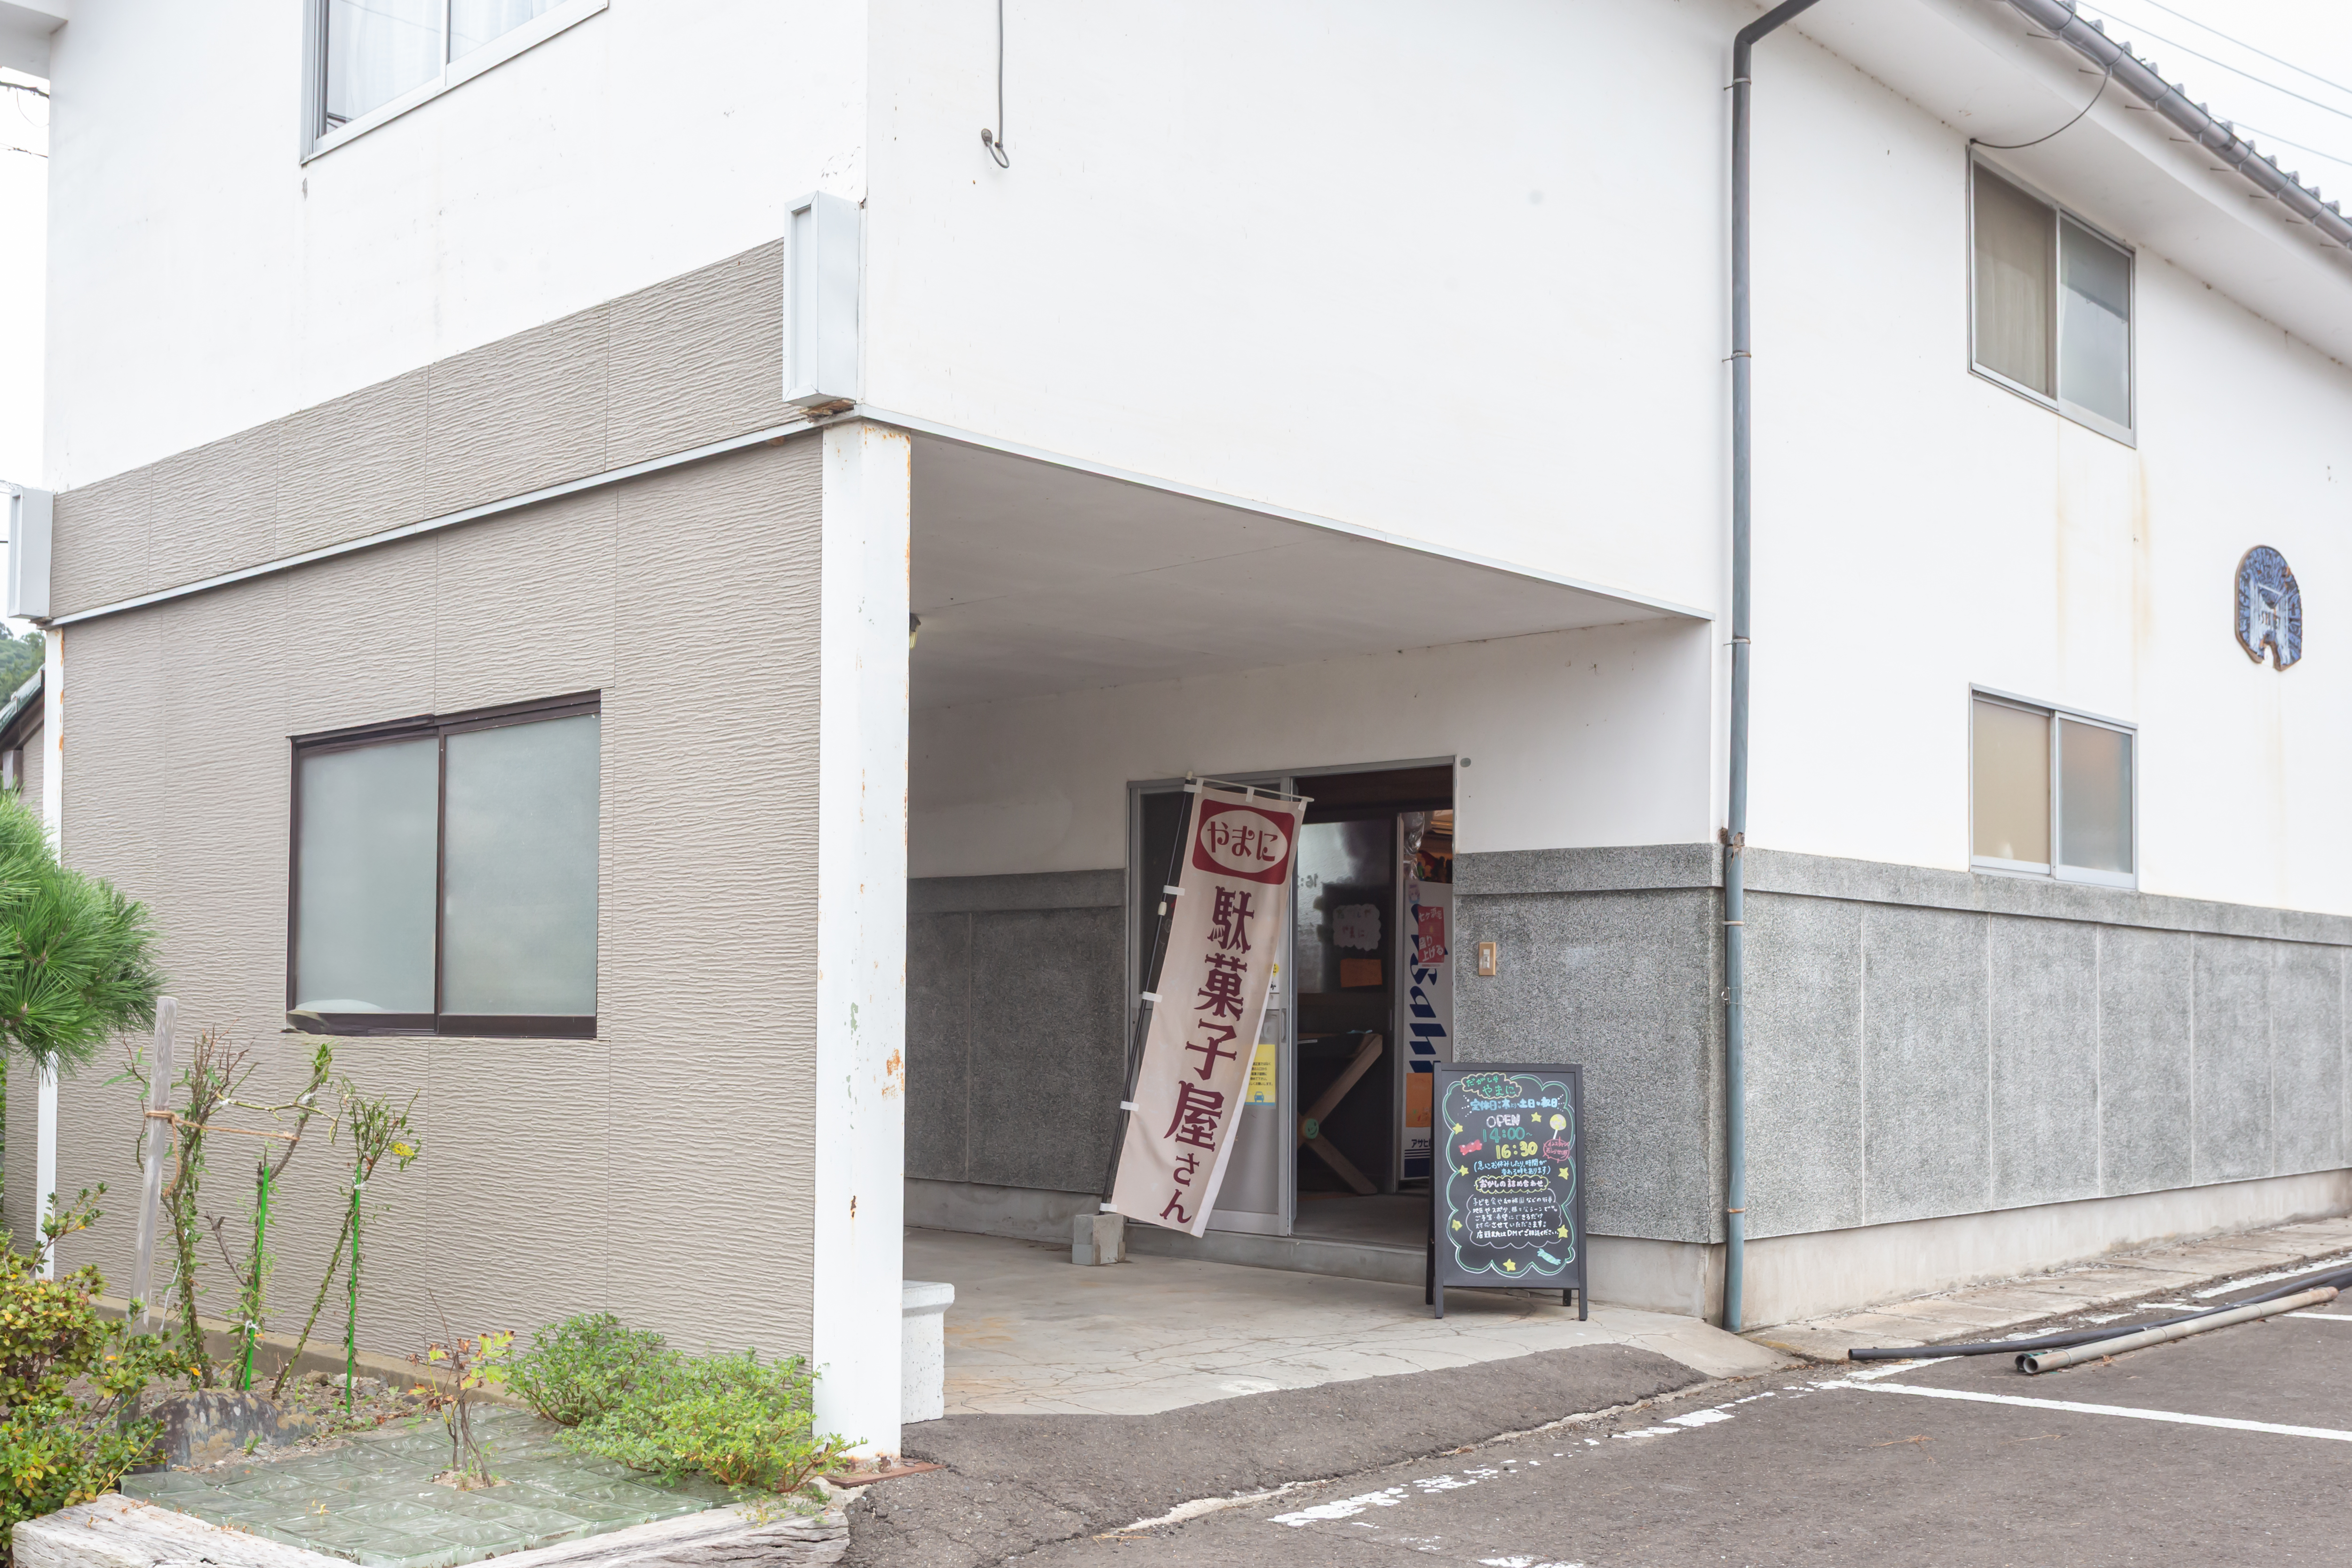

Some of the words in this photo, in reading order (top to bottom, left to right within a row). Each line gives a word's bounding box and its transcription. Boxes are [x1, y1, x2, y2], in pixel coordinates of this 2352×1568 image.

[1207, 821, 1278, 862] やまに
[1422, 944, 1444, 962] 上げる
[1159, 885, 1255, 1224] 駄菓子屋さん
[1466, 1075, 1499, 1087] だがしや
[1482, 1084, 1516, 1098] やまに
[1486, 1114, 1520, 1128] OPEN
[1412, 1138, 1430, 1148] アサヒ
[1496, 1141, 1538, 1159] 16:30
[1479, 1178, 1543, 1188] おかしの詰め合わせ
